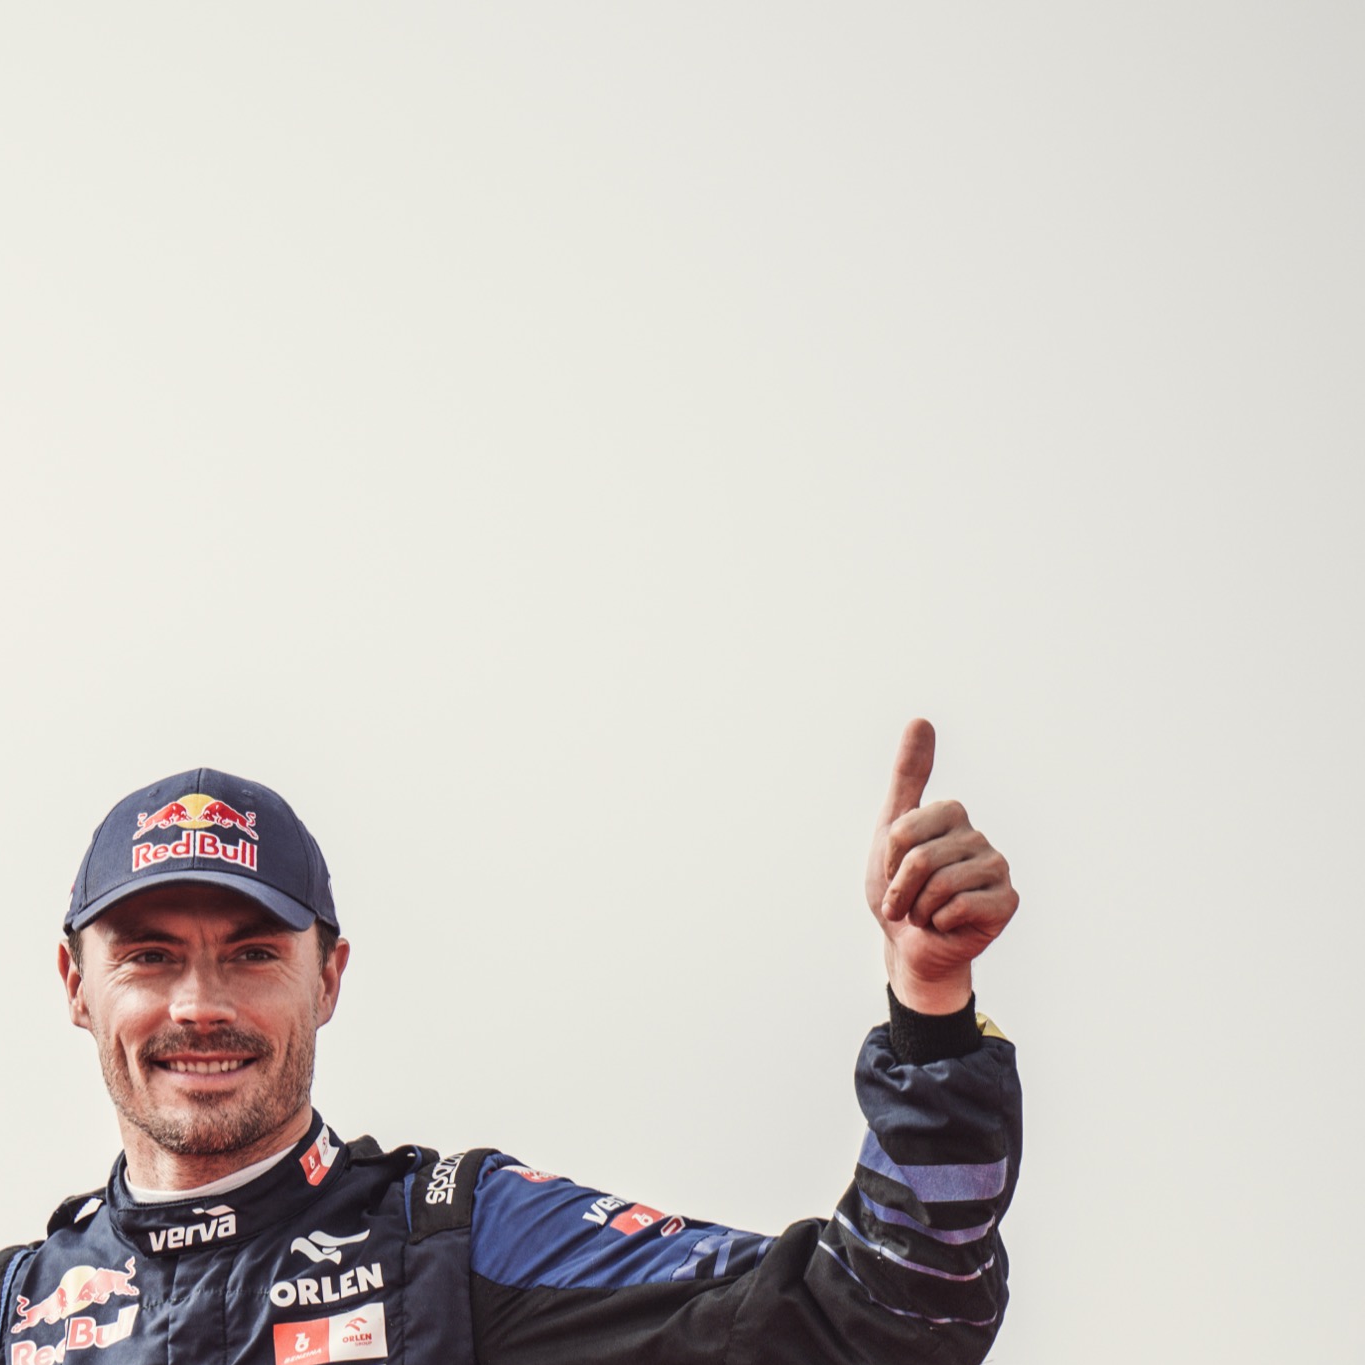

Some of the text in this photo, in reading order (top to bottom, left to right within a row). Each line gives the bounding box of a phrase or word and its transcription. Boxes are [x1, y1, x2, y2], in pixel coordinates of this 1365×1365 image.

[132, 830, 258, 872] Red Bull
[149, 1213, 237, 1252] verva
[269, 1263, 384, 1308] ORLEN
[284, 1348, 323, 1365] BENZINA
[342, 1333, 373, 1344] ORLEN
